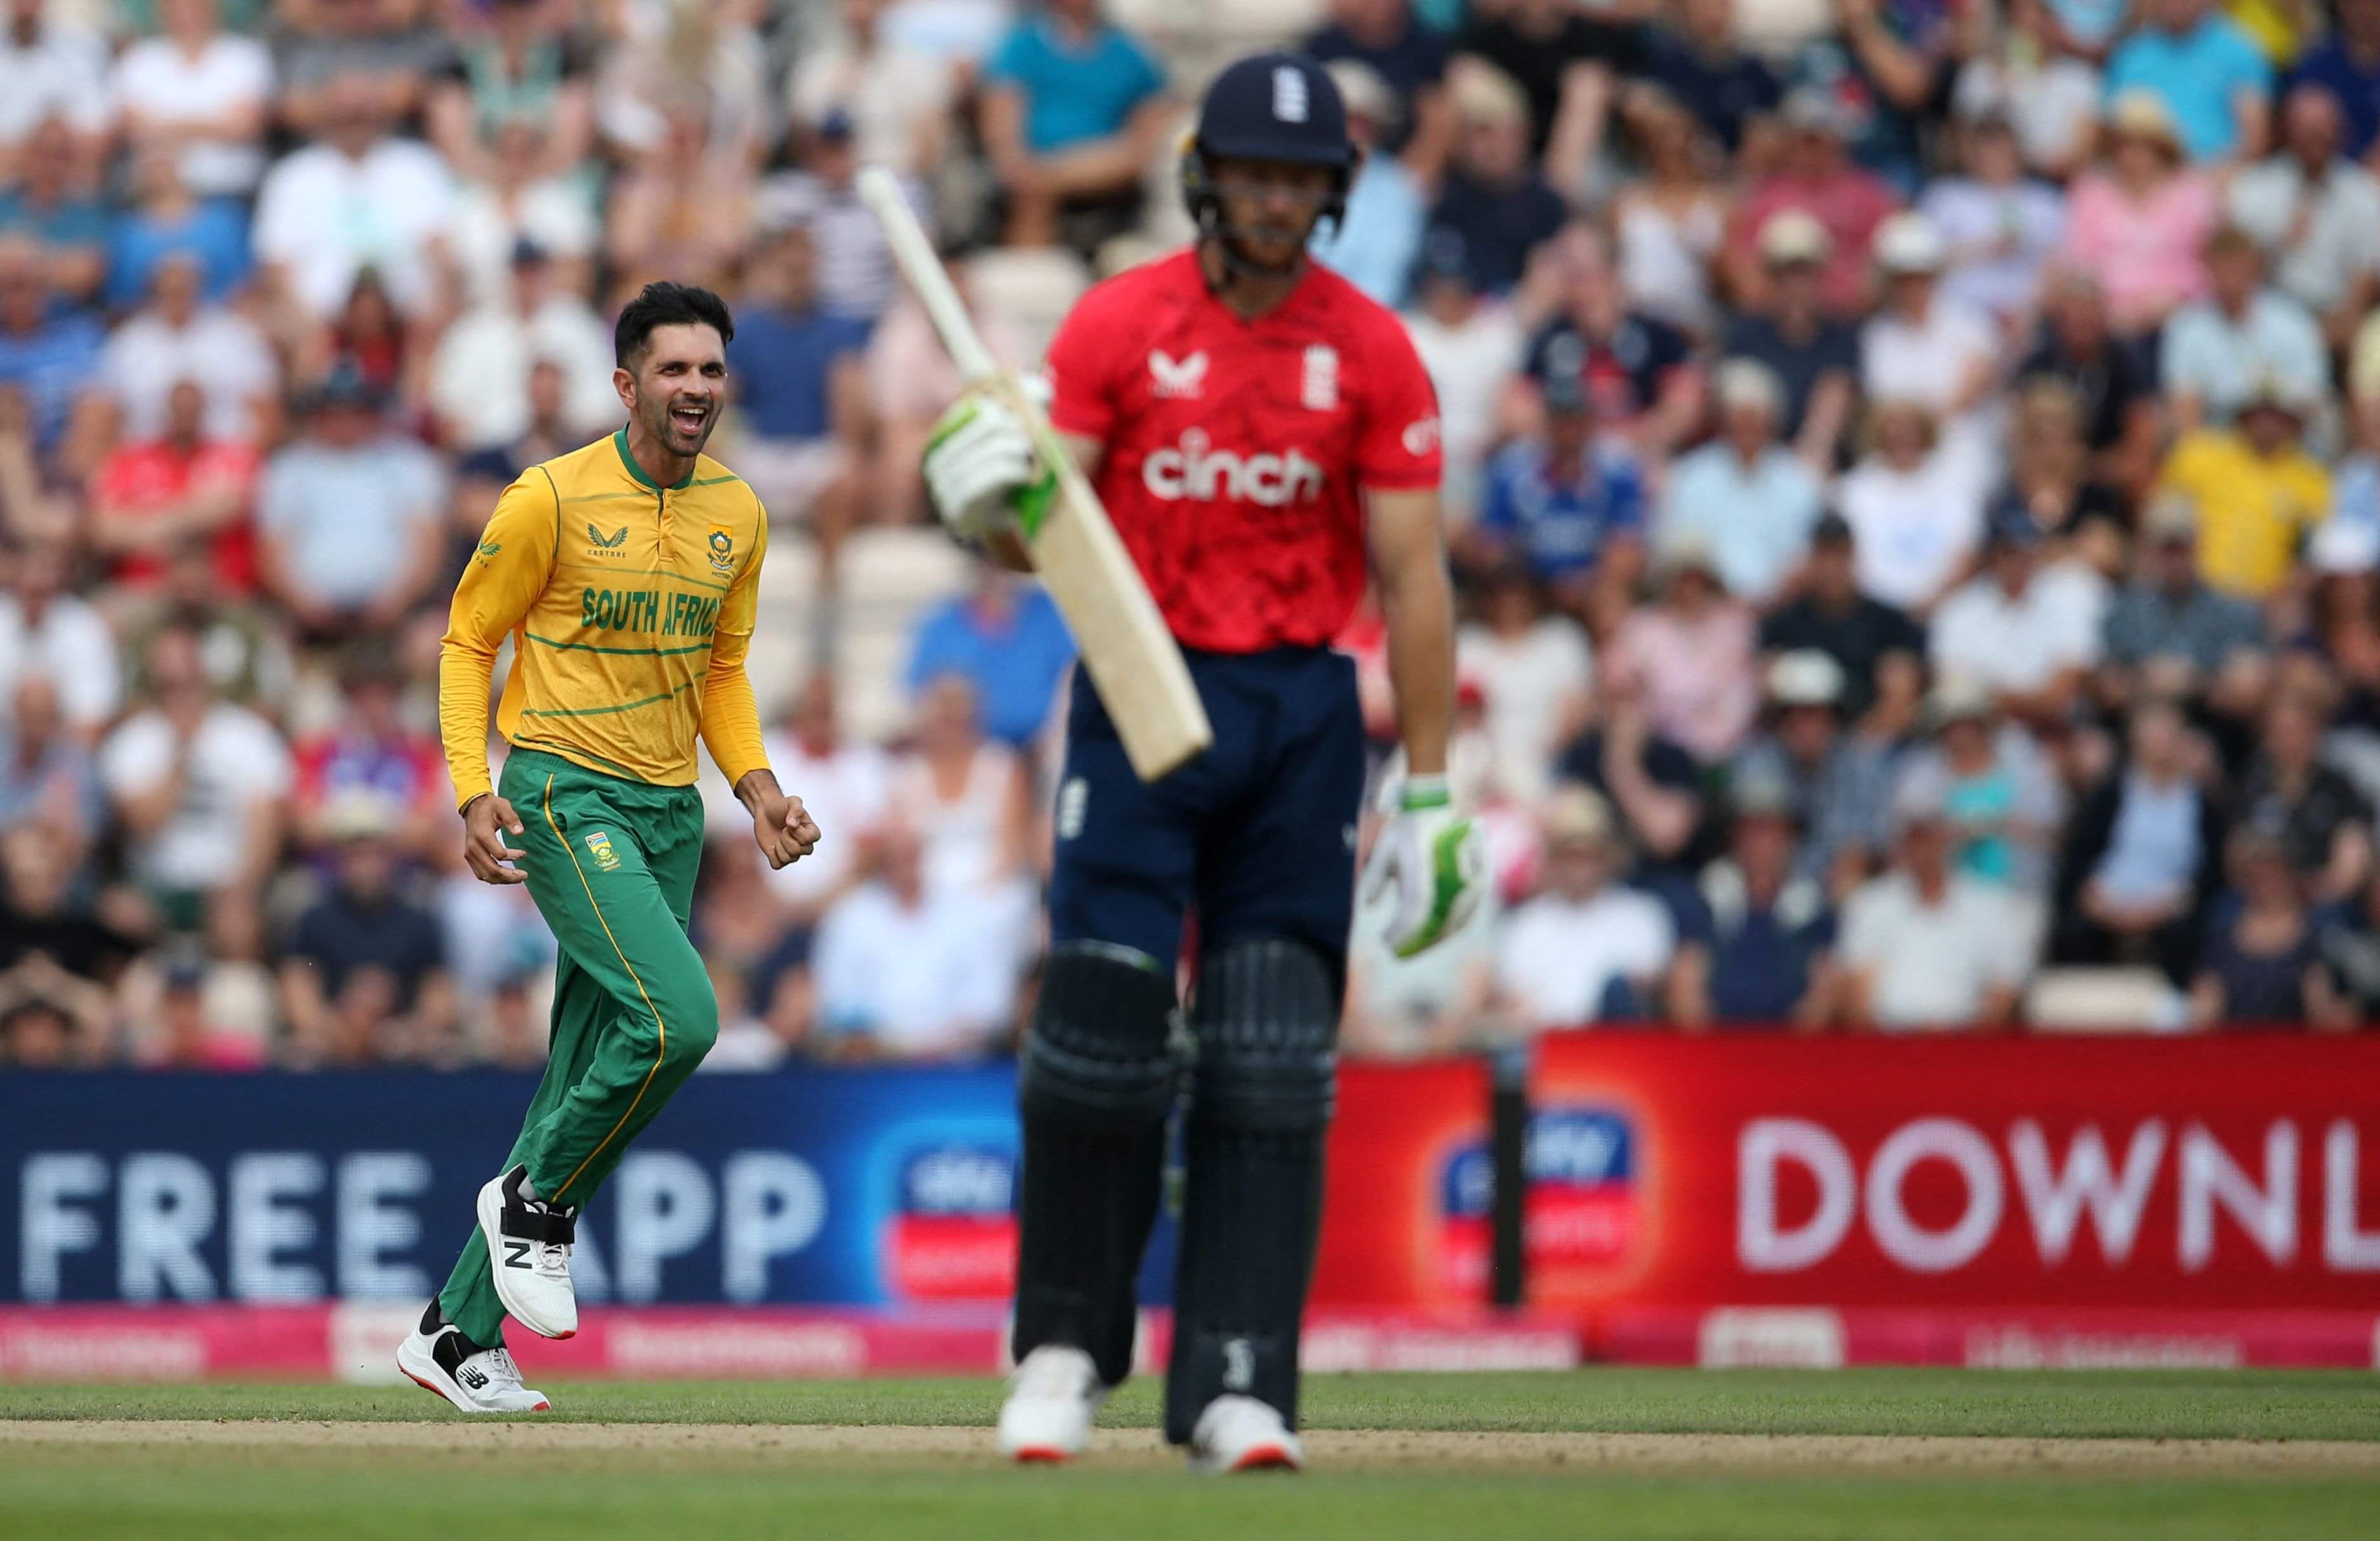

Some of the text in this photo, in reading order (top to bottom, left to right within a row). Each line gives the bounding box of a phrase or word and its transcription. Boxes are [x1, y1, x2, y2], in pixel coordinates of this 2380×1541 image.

[1142, 425, 1323, 507] cinch
[587, 549, 626, 558] CASTORE
[582, 587, 722, 636] SOUTH AFRIC
[19, 1151, 434, 1303] FREE
[1735, 1116, 2380, 1273] DOWNL
